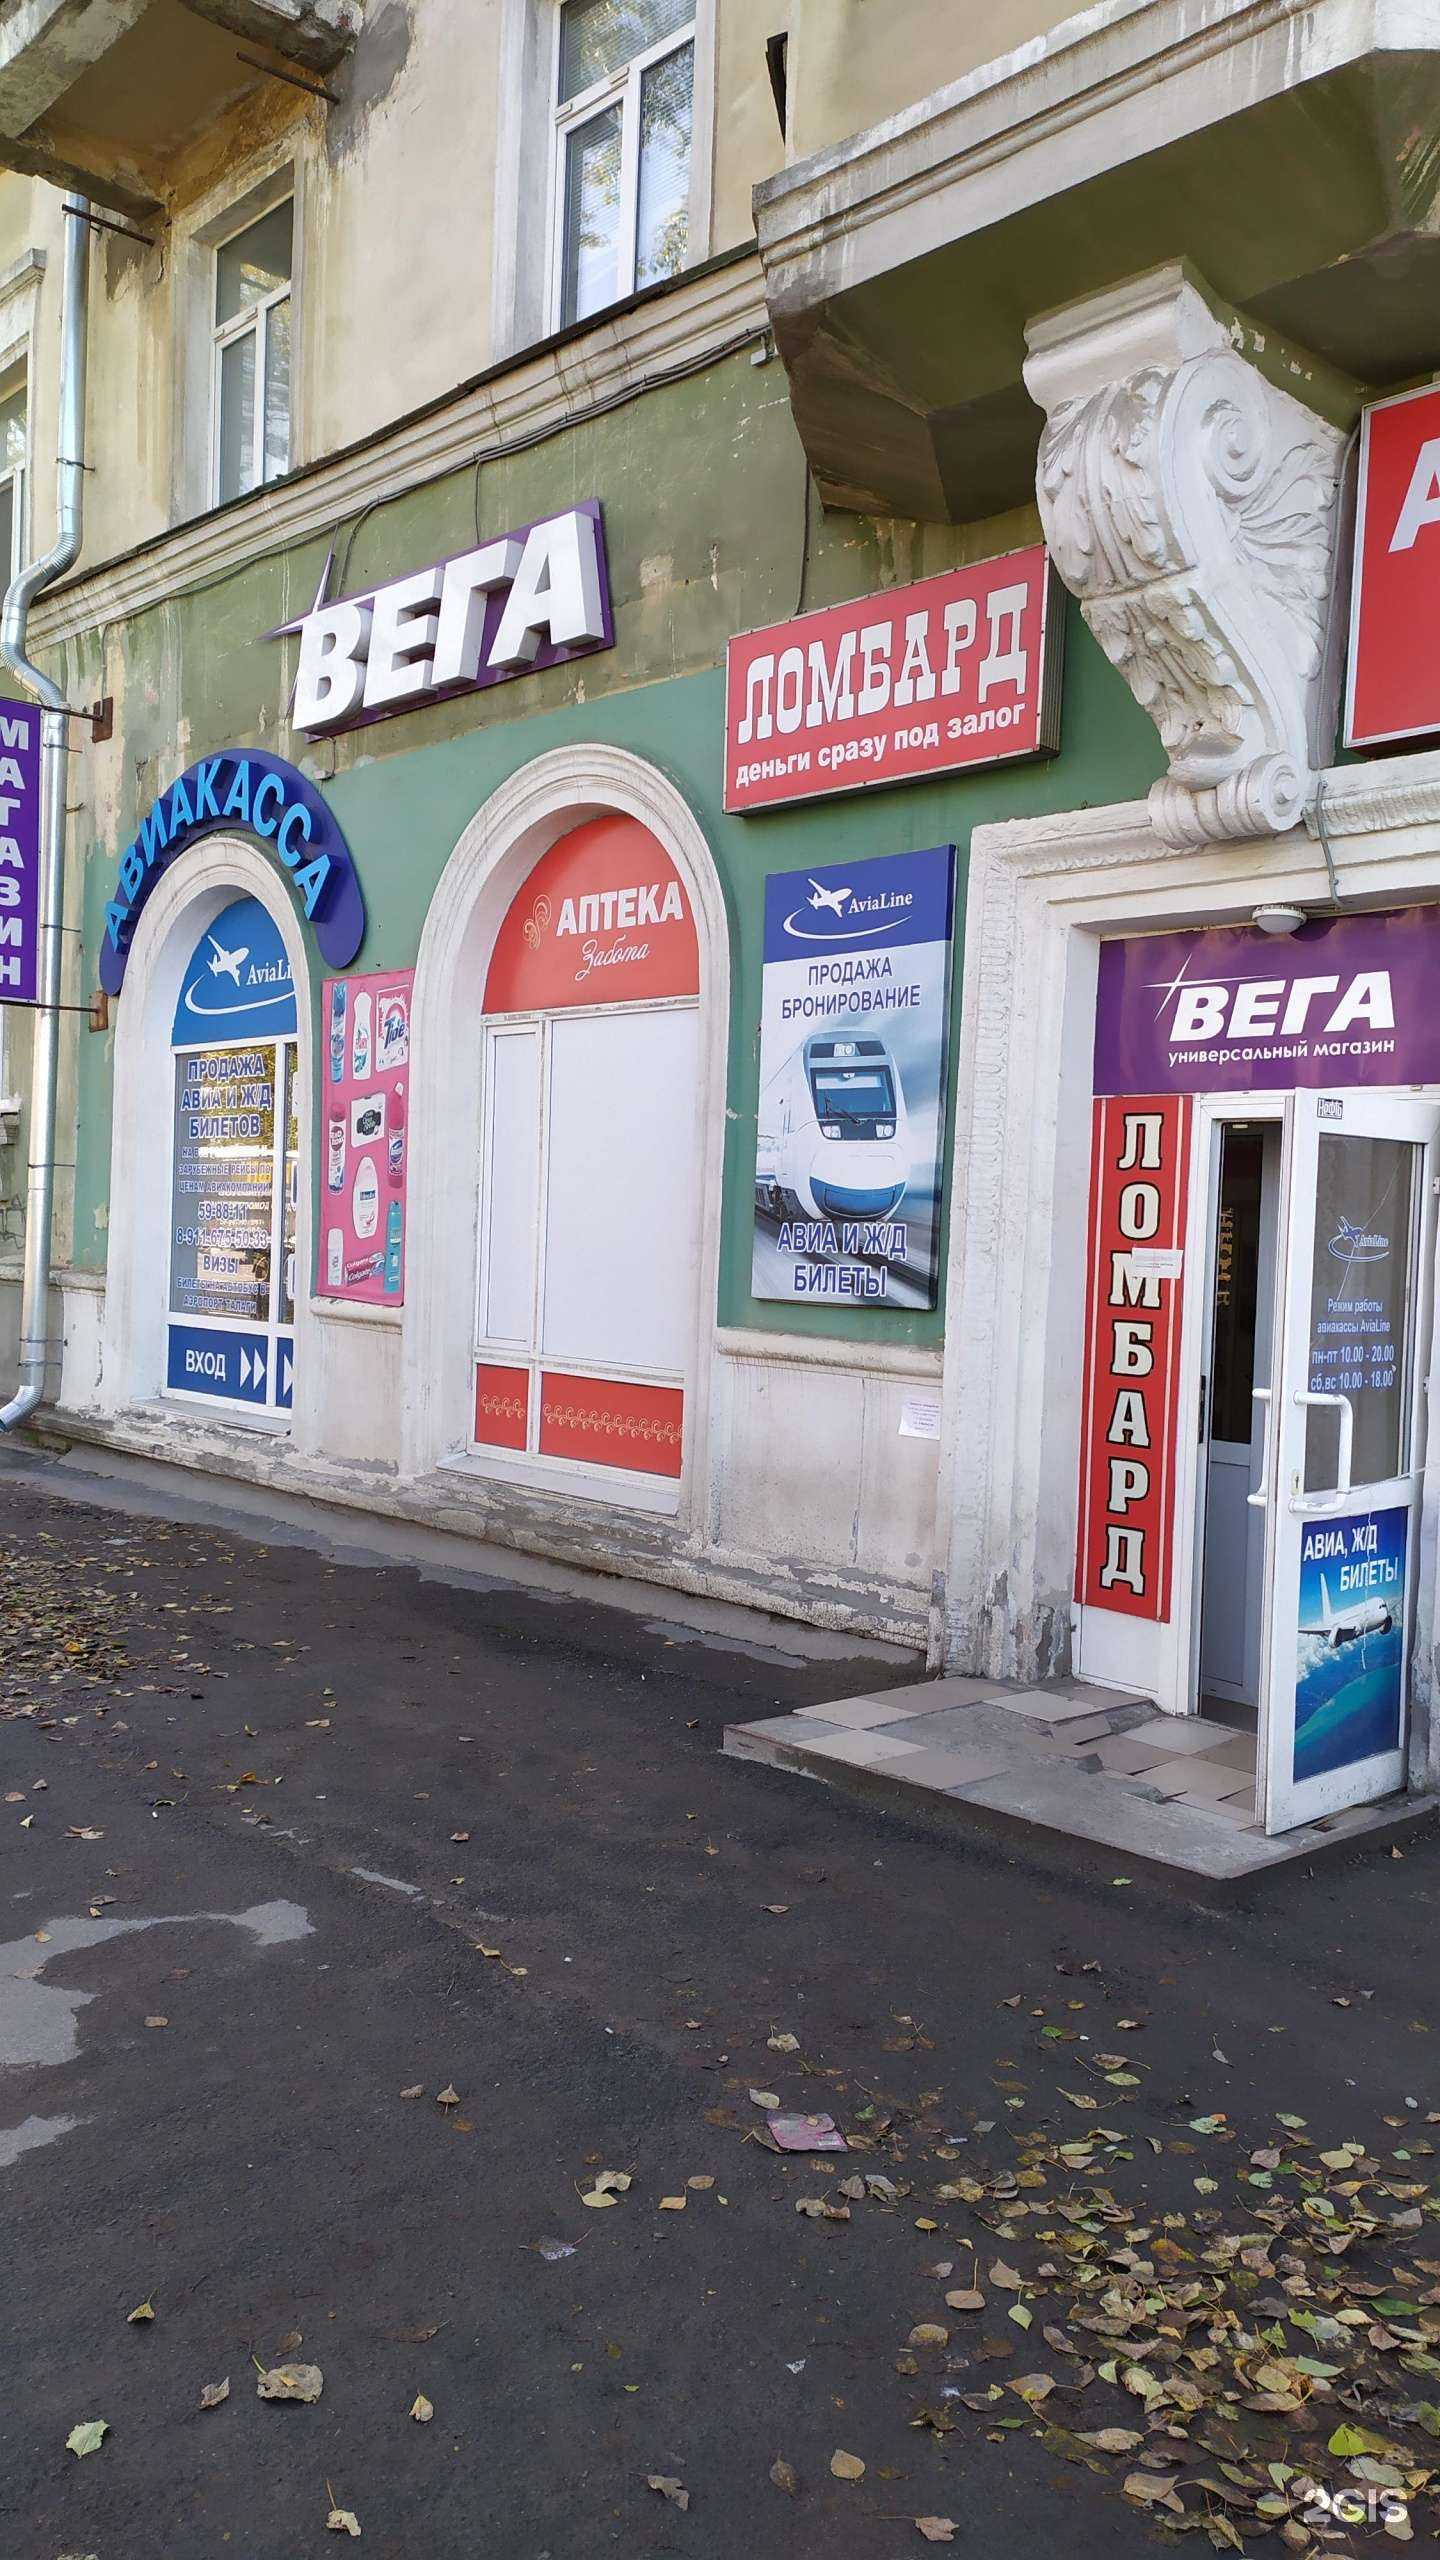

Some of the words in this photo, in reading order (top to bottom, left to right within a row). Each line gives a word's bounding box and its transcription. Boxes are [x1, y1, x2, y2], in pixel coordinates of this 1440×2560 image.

[292, 510, 604, 732] ВЕГА
[737, 582, 1029, 745] ЛОМБАРД
[735, 750, 811, 789] деньги
[817, 733, 888, 771] сразу
[894, 723, 940, 751] под
[946, 703, 1027, 740] залог
[104, 757, 332, 953] АВИАКАССА
[556, 881, 684, 937] АПТЕКА
[847, 891, 913, 914] AviaLine
[574, 933, 650, 981] Забота
[808, 956, 893, 986] ПРОДАЖА
[781, 984, 921, 1020] БРОНИРОВАНИЕ
[1168, 969, 1396, 1042] ВЕГА
[188, 1054, 265, 1082] ПРОДАЖА
[1168, 1039, 1308, 1067] универсальный
[1312, 1039, 1395, 1057] магазин
[180, 1086, 222, 1112] АВИА
[226, 1085, 237, 1109] И
[189, 1114, 261, 1139] БИЛЕТОВ
[197, 1201, 247, 1221] 59-88-11
[776, 1222, 839, 1254] АВИА
[842, 1222, 859, 1255] И
[861, 1222, 908, 1262] Ж/Д
[202, 1254, 240, 1275] ВИЗЫ
[793, 1263, 888, 1297] БИЛЕТЫ
[1327, 1299, 1353, 1313] Режим
[1354, 1298, 1384, 1315] работы
[1317, 1321, 1359, 1334] авиакассы
[1360, 1319, 1391, 1333] AviaLine
[185, 1349, 227, 1382] ВХОД
[1099, 1112, 1165, 1597] ЛОМБАРД
[1312, 1350, 1338, 1364] пн-пт
[1340, 1345, 1364, 1362] 10.00
[1371, 1345, 1395, 1362] 20.00
[1310, 1373, 1337, 1392] сб,вс
[1339, 1371, 1363, 1389] 10.00
[1370, 1370, 1394, 1388] 18.00
[1303, 1529, 1348, 1562] АВИА,
[1351, 1524, 1378, 1554] Ж/Д
[1340, 1556, 1399, 1592] БИЛЕТЫ
